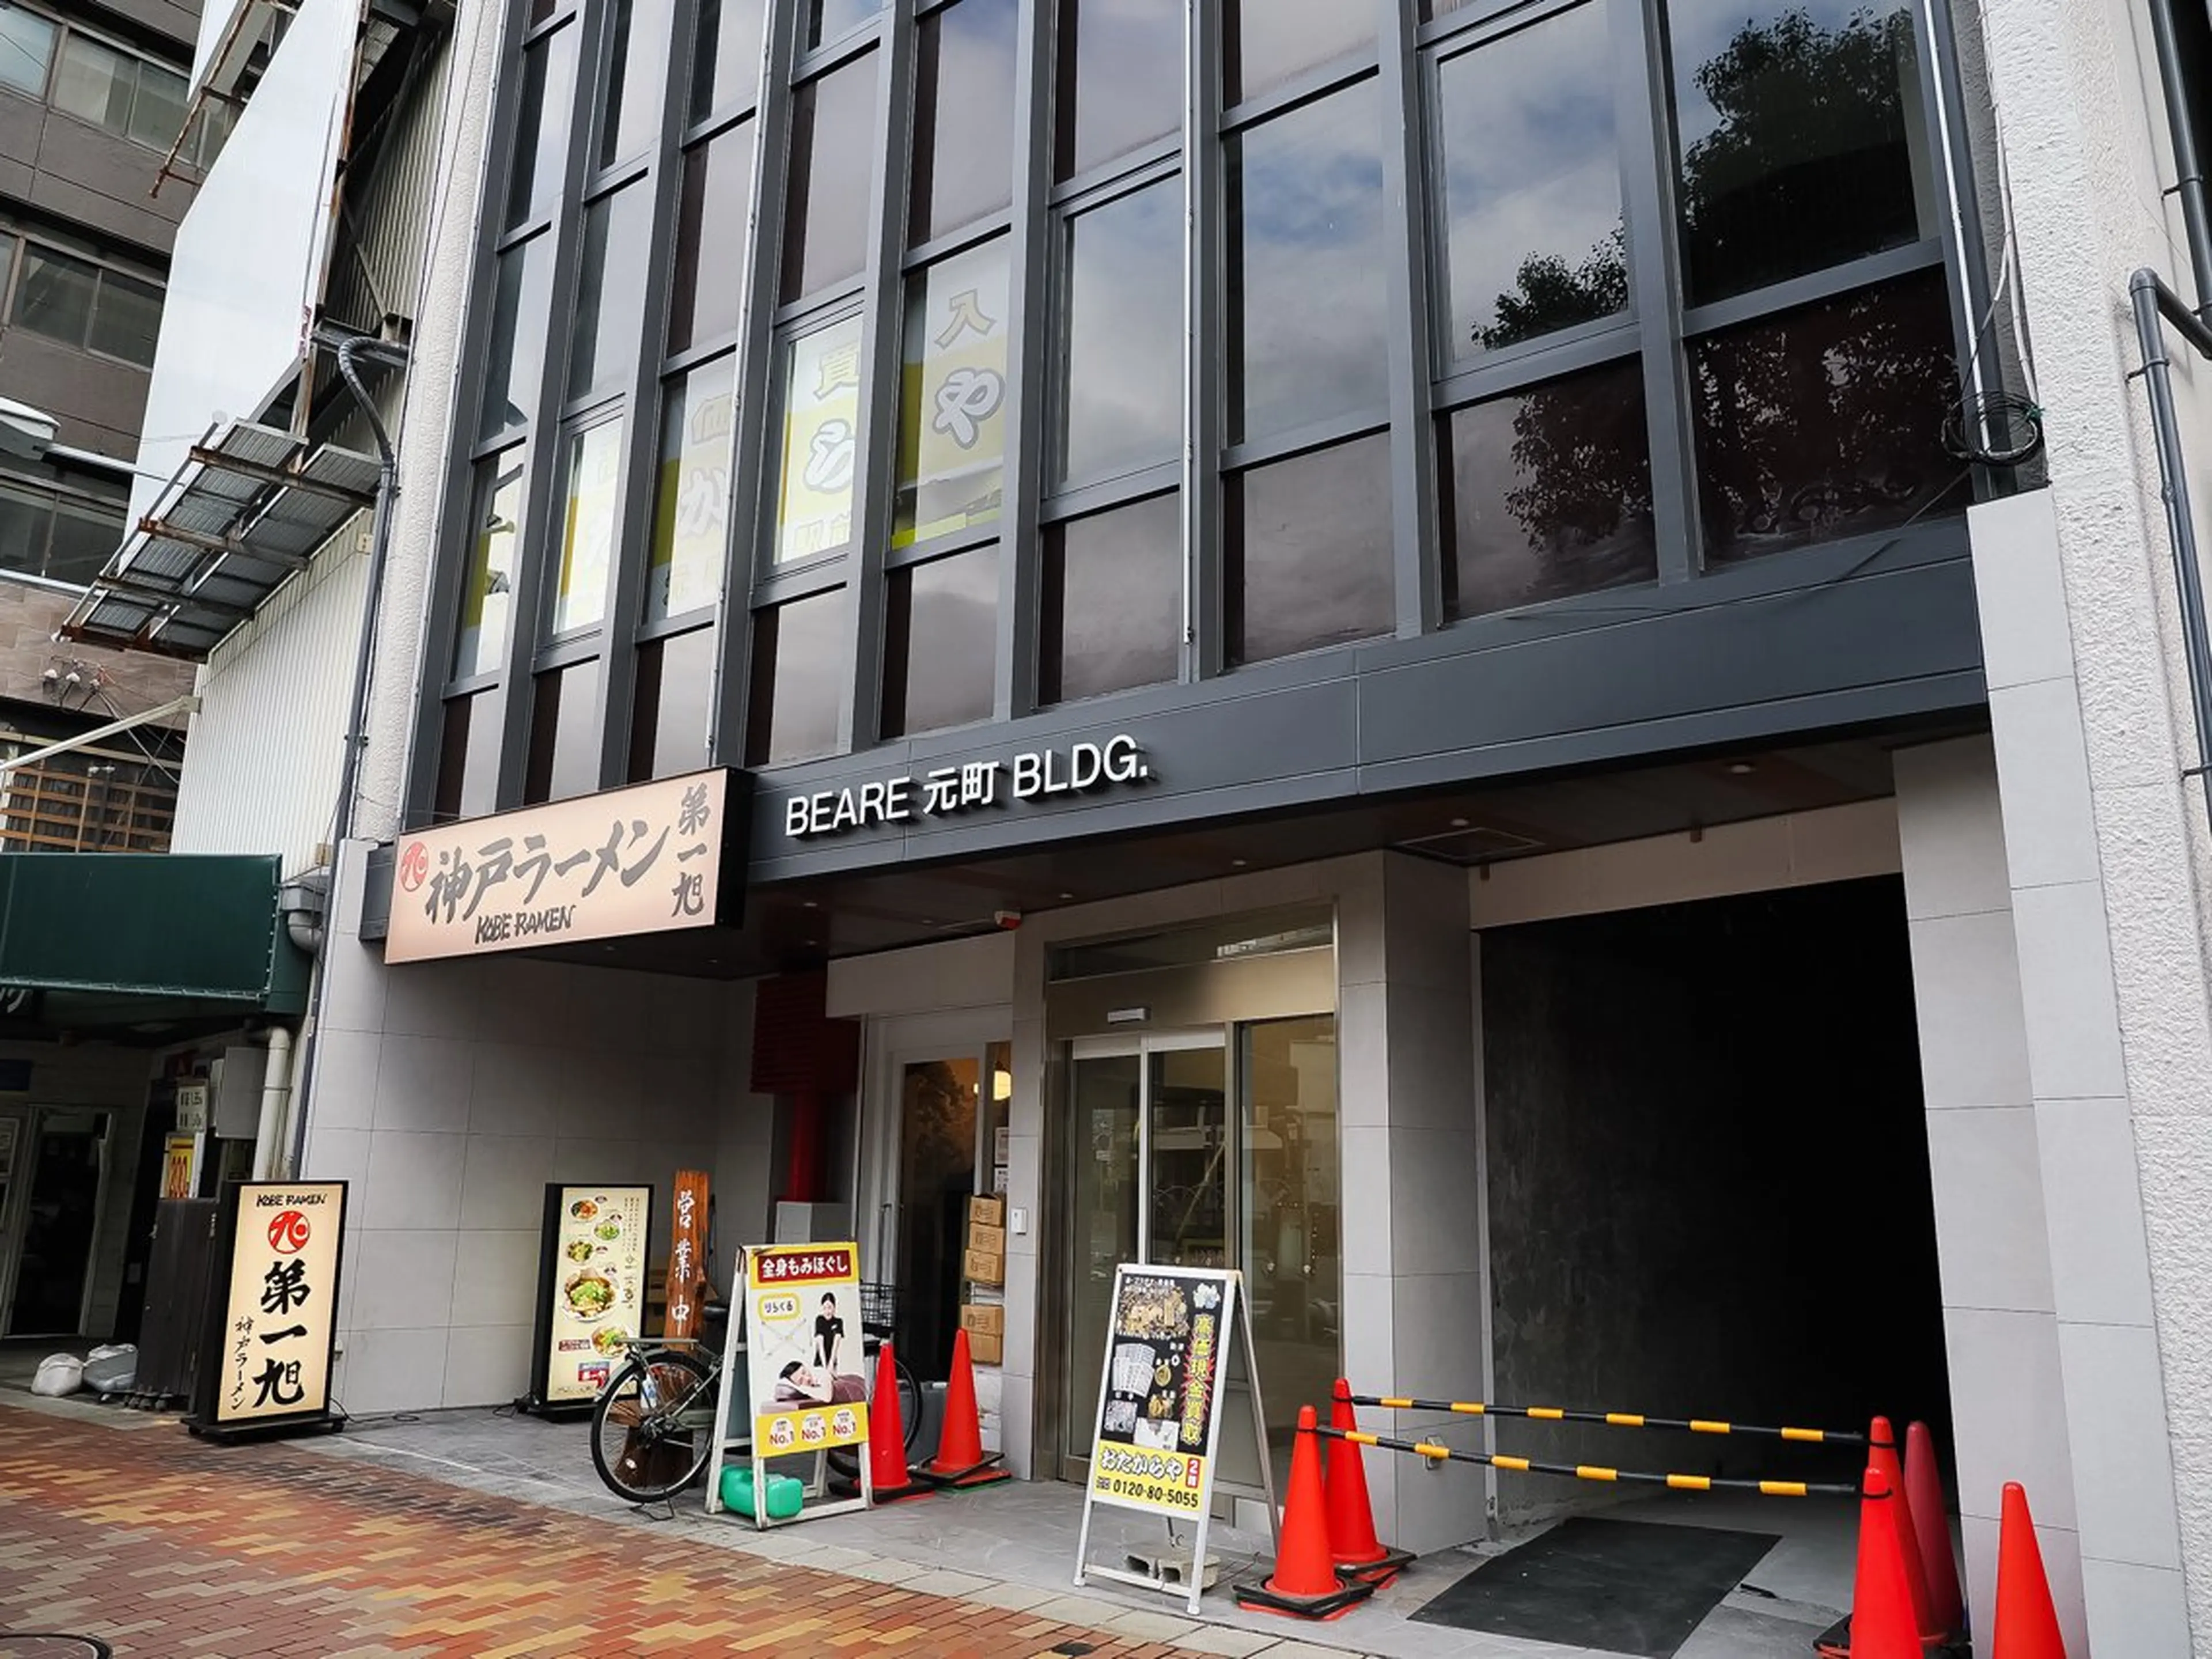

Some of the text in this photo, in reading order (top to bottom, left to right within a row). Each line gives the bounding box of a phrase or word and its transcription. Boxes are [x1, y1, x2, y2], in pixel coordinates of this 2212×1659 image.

[785, 734, 1149, 836] BEARE 元町 BLDG.
[425, 820, 671, 924] 神戸ラーメン
[671, 782, 711, 918] 第一旭
[474, 904, 578, 945] KOBE RAMEN
[256, 1193, 328, 1208] KOBE RAMEN
[671, 1190, 696, 1336] 営業中
[762, 1255, 849, 1279] 全身もみほぐし
[252, 1257, 311, 1408] 第一旭
[764, 1299, 795, 1315] りらくる
[231, 1316, 255, 1411] 神戸ラーメン
[1101, 1447, 1184, 1482] おたからや
[1113, 1479, 1199, 1508] 0120-80-5055
